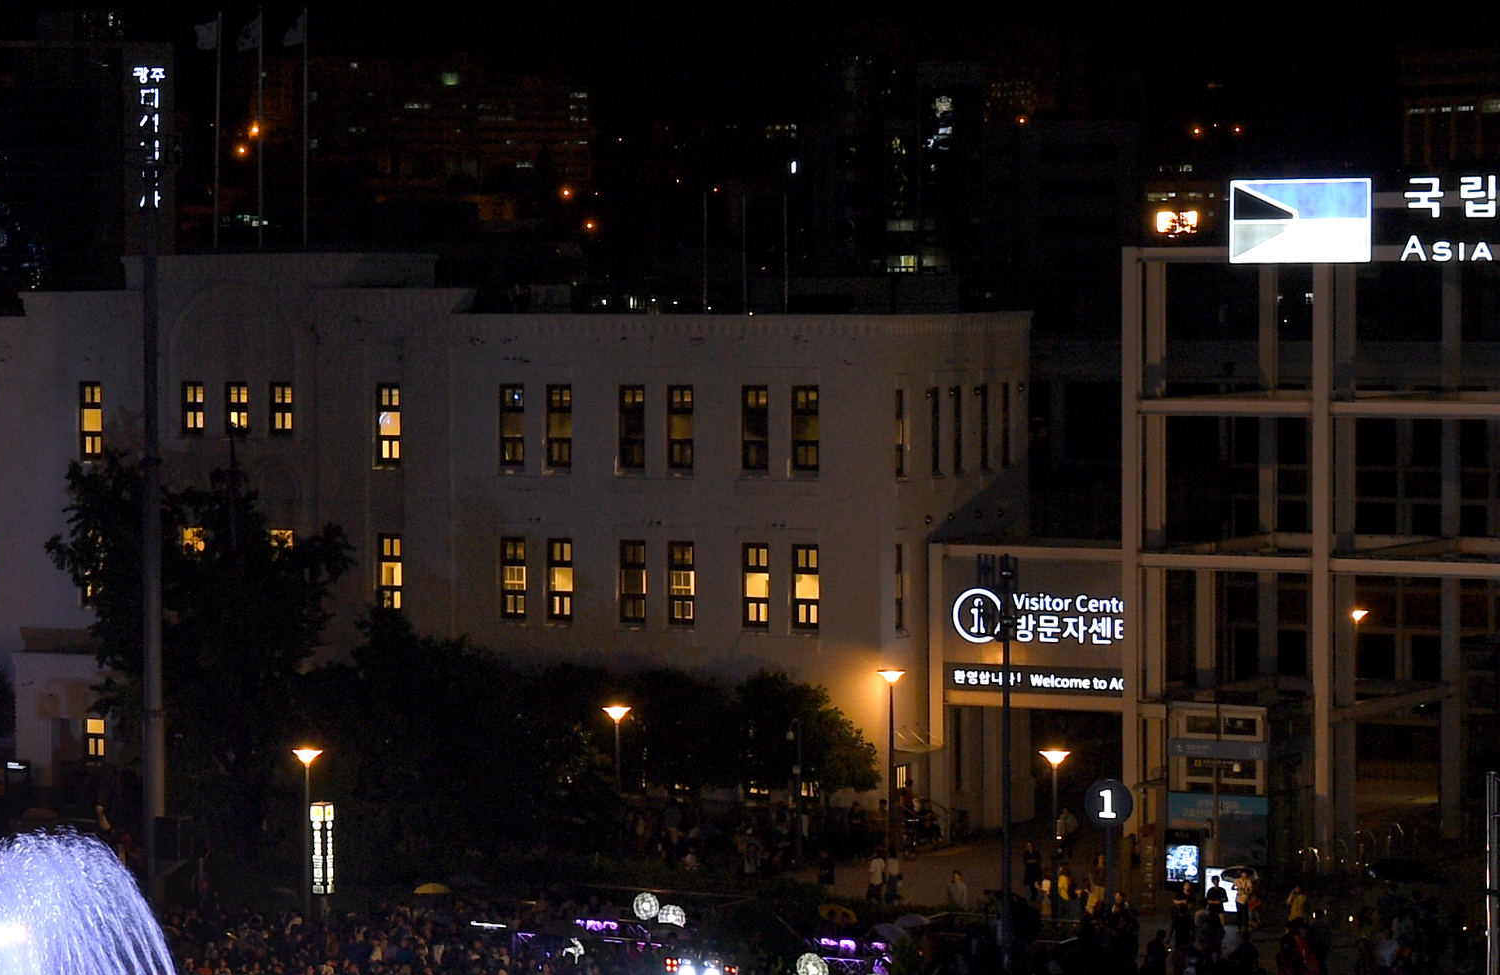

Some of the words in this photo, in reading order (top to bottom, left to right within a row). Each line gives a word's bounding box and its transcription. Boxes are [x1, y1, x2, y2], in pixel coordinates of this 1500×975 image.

[132, 67, 165, 84] 광주
[1404, 174, 1497, 218] 국립
[1400, 234, 1493, 262] ASIA
[1012, 593, 1073, 612] Visitor
[1029, 673, 1091, 690] Welcome
[1092, 677, 1108, 690] to
[1098, 789, 1117, 819] 1
